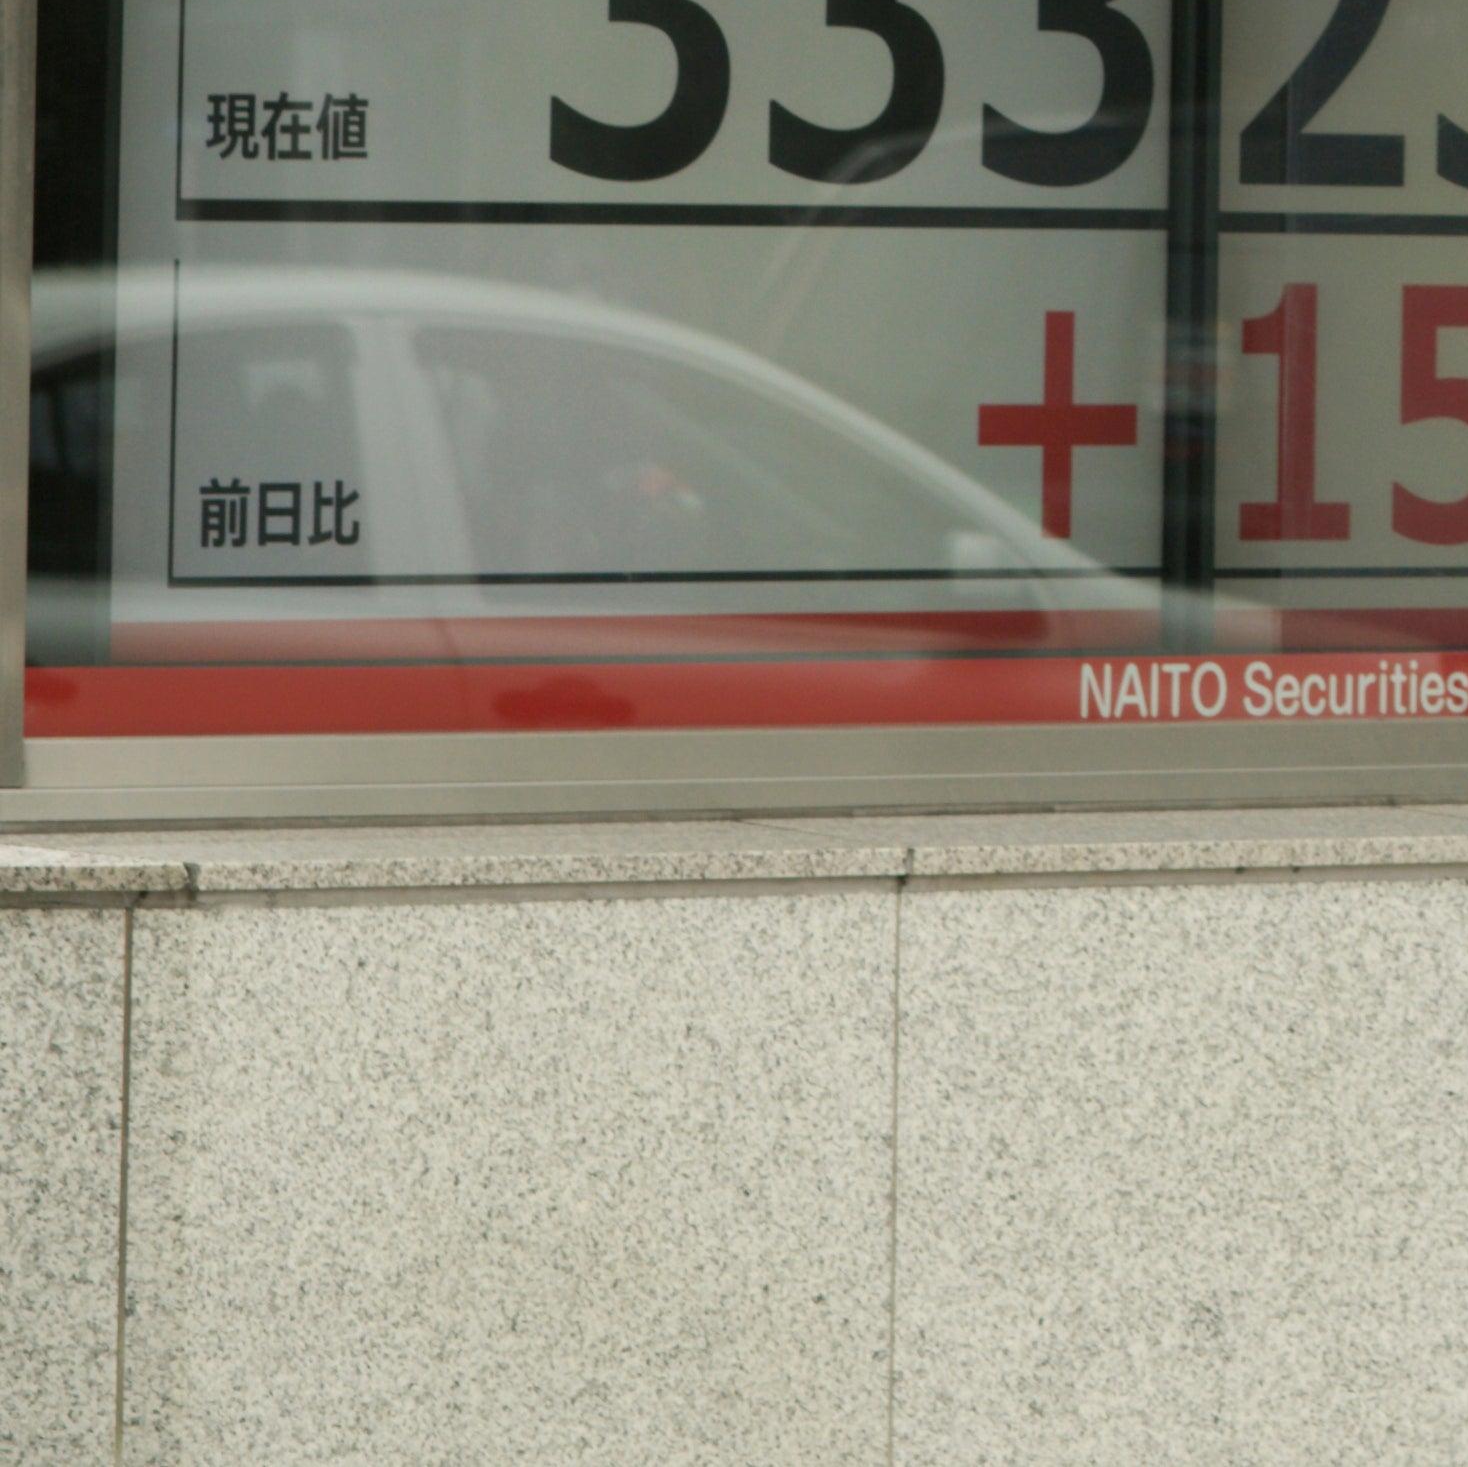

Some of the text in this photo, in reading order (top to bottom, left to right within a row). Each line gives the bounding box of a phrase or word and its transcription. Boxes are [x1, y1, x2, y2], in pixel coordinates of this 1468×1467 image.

[205, 90, 369, 161] 現在値
[199, 476, 361, 549] 前日比
[1079, 661, 1228, 719] NAITO
